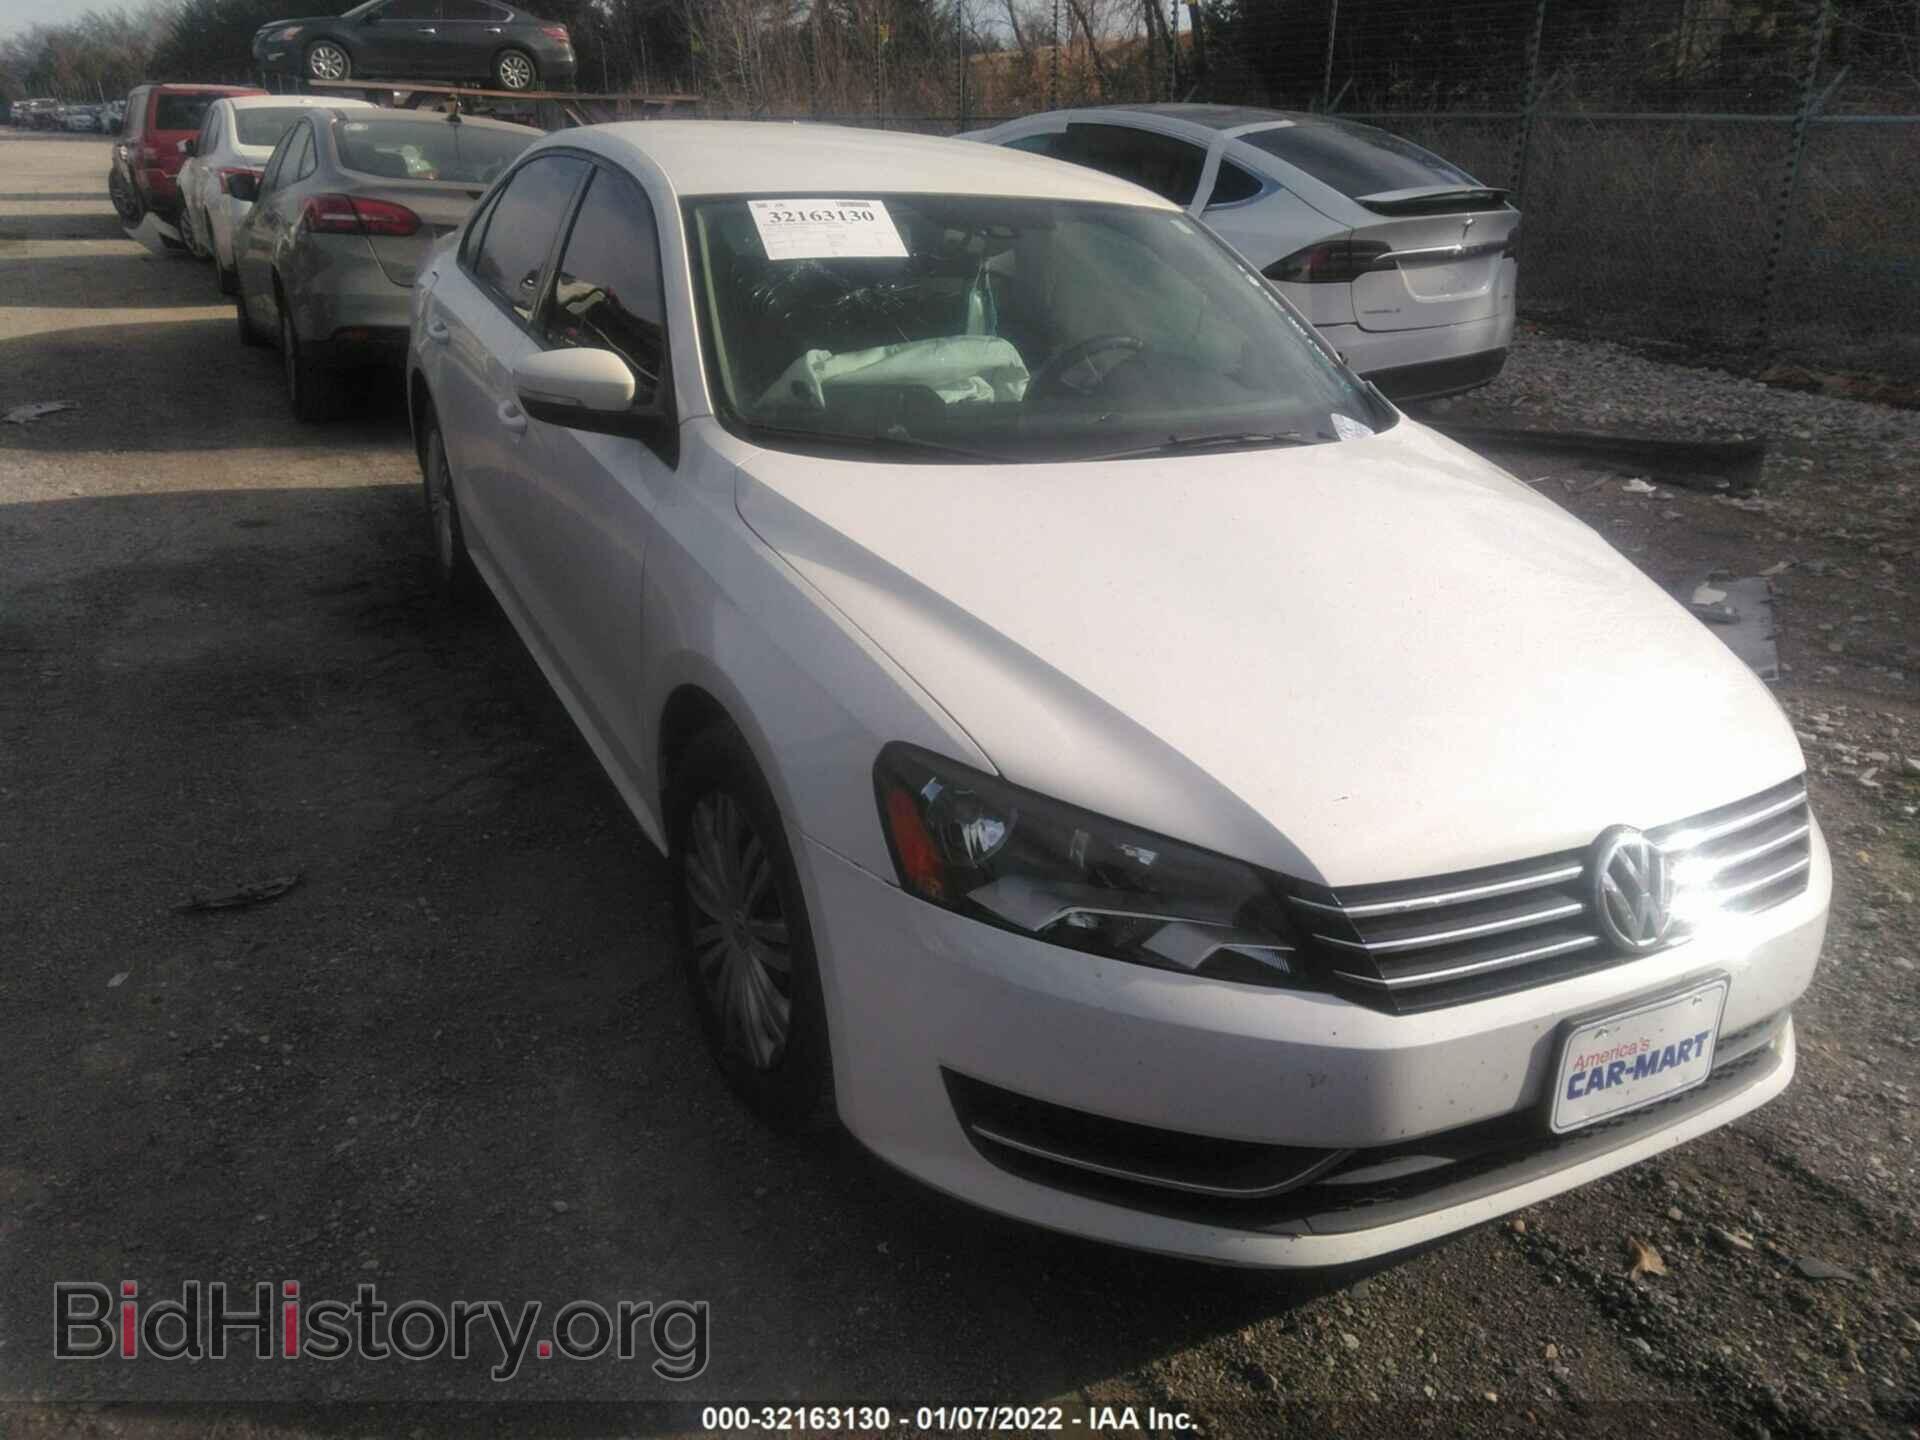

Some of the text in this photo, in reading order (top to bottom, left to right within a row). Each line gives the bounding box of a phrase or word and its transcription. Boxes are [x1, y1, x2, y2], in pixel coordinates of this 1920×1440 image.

[768, 210, 876, 224] 32163130
[1566, 1029, 1711, 1100] CAR-MART
[1573, 1037, 1651, 1072] America's
